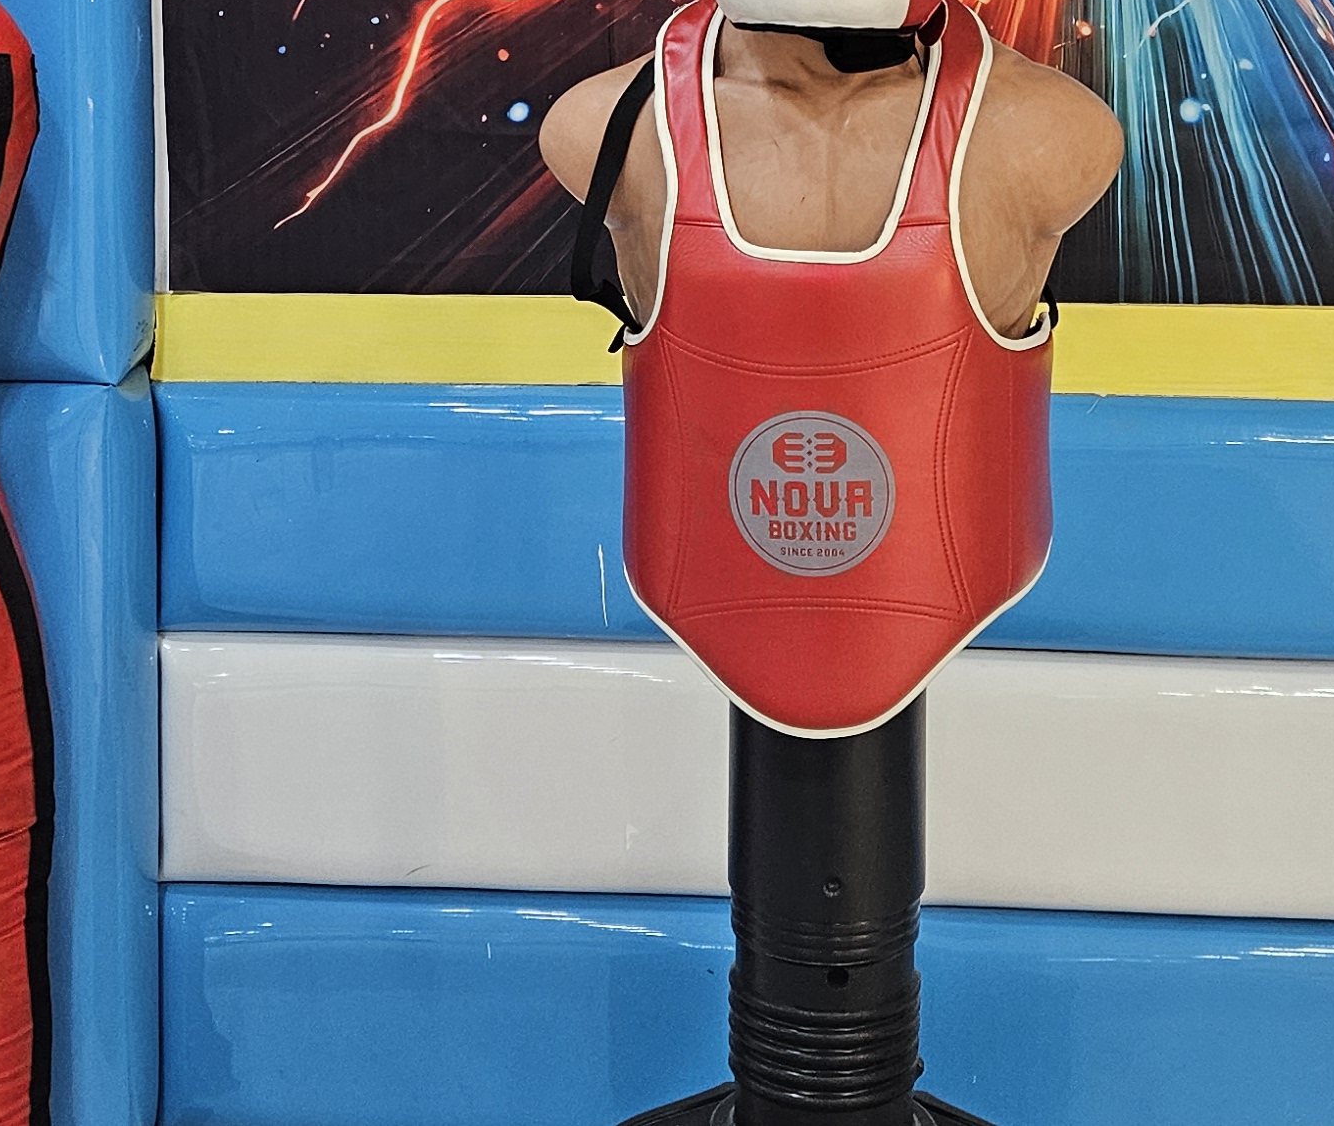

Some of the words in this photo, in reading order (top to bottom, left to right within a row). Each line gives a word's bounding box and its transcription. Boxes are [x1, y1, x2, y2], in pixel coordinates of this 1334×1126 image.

[750, 478, 874, 518] NOVA
[768, 520, 857, 542] BOXING
[780, 546, 813, 557] SINCE
[816, 548, 845, 557] 2004
